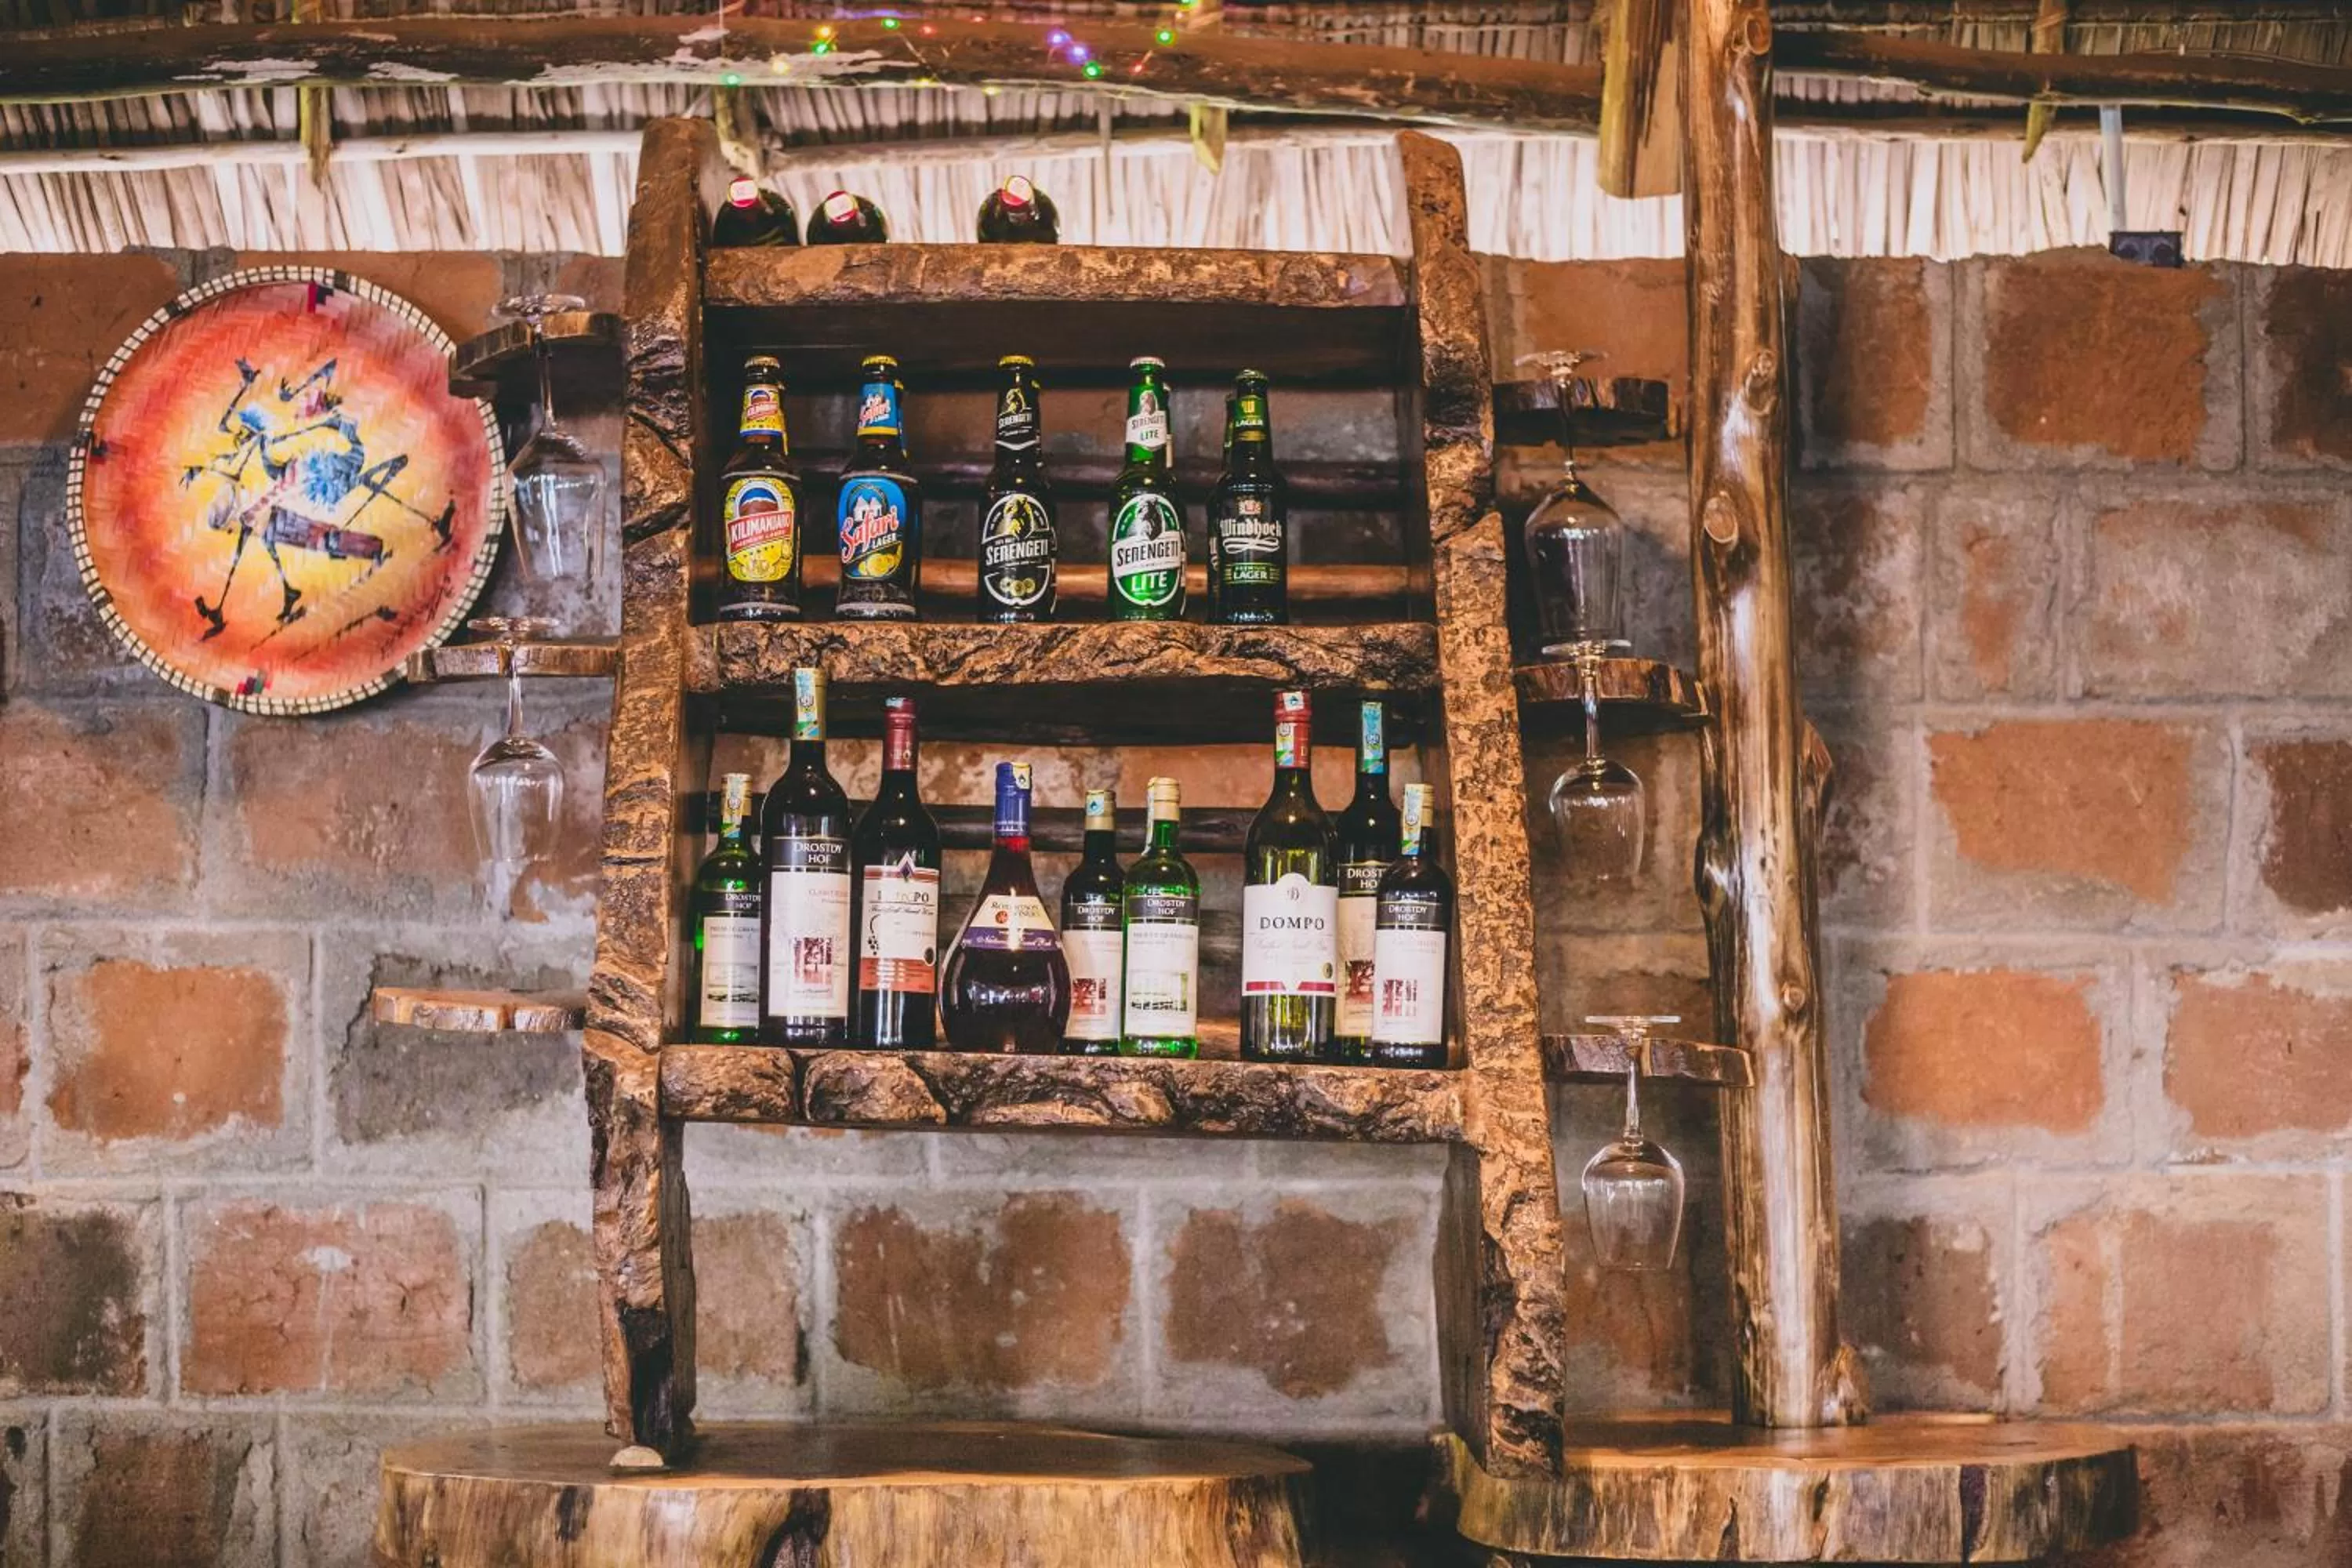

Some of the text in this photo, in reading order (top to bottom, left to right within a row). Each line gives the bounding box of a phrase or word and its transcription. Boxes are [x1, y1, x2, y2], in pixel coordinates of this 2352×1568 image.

[1140, 429, 1159, 441] LITE
[840, 506, 899, 564] Safari
[872, 532, 898, 550] LAGER
[985, 539, 1049, 565] SERENGETI
[1116, 540, 1178, 567] SERENGETI
[1233, 571, 1268, 579] LAGER
[1131, 572, 1167, 592] LITE
[793, 841, 843, 854] DROSTDY
[808, 854, 832, 864] HOF
[1348, 867, 1387, 879] DROST
[1360, 879, 1377, 888] HO
[724, 893, 761, 902] DROSTD
[1147, 898, 1185, 907] DROSTDY
[1077, 906, 1116, 916] DROSTDY
[1388, 905, 1428, 915] DROSTDY
[1259, 916, 1325, 931] DOMPO
